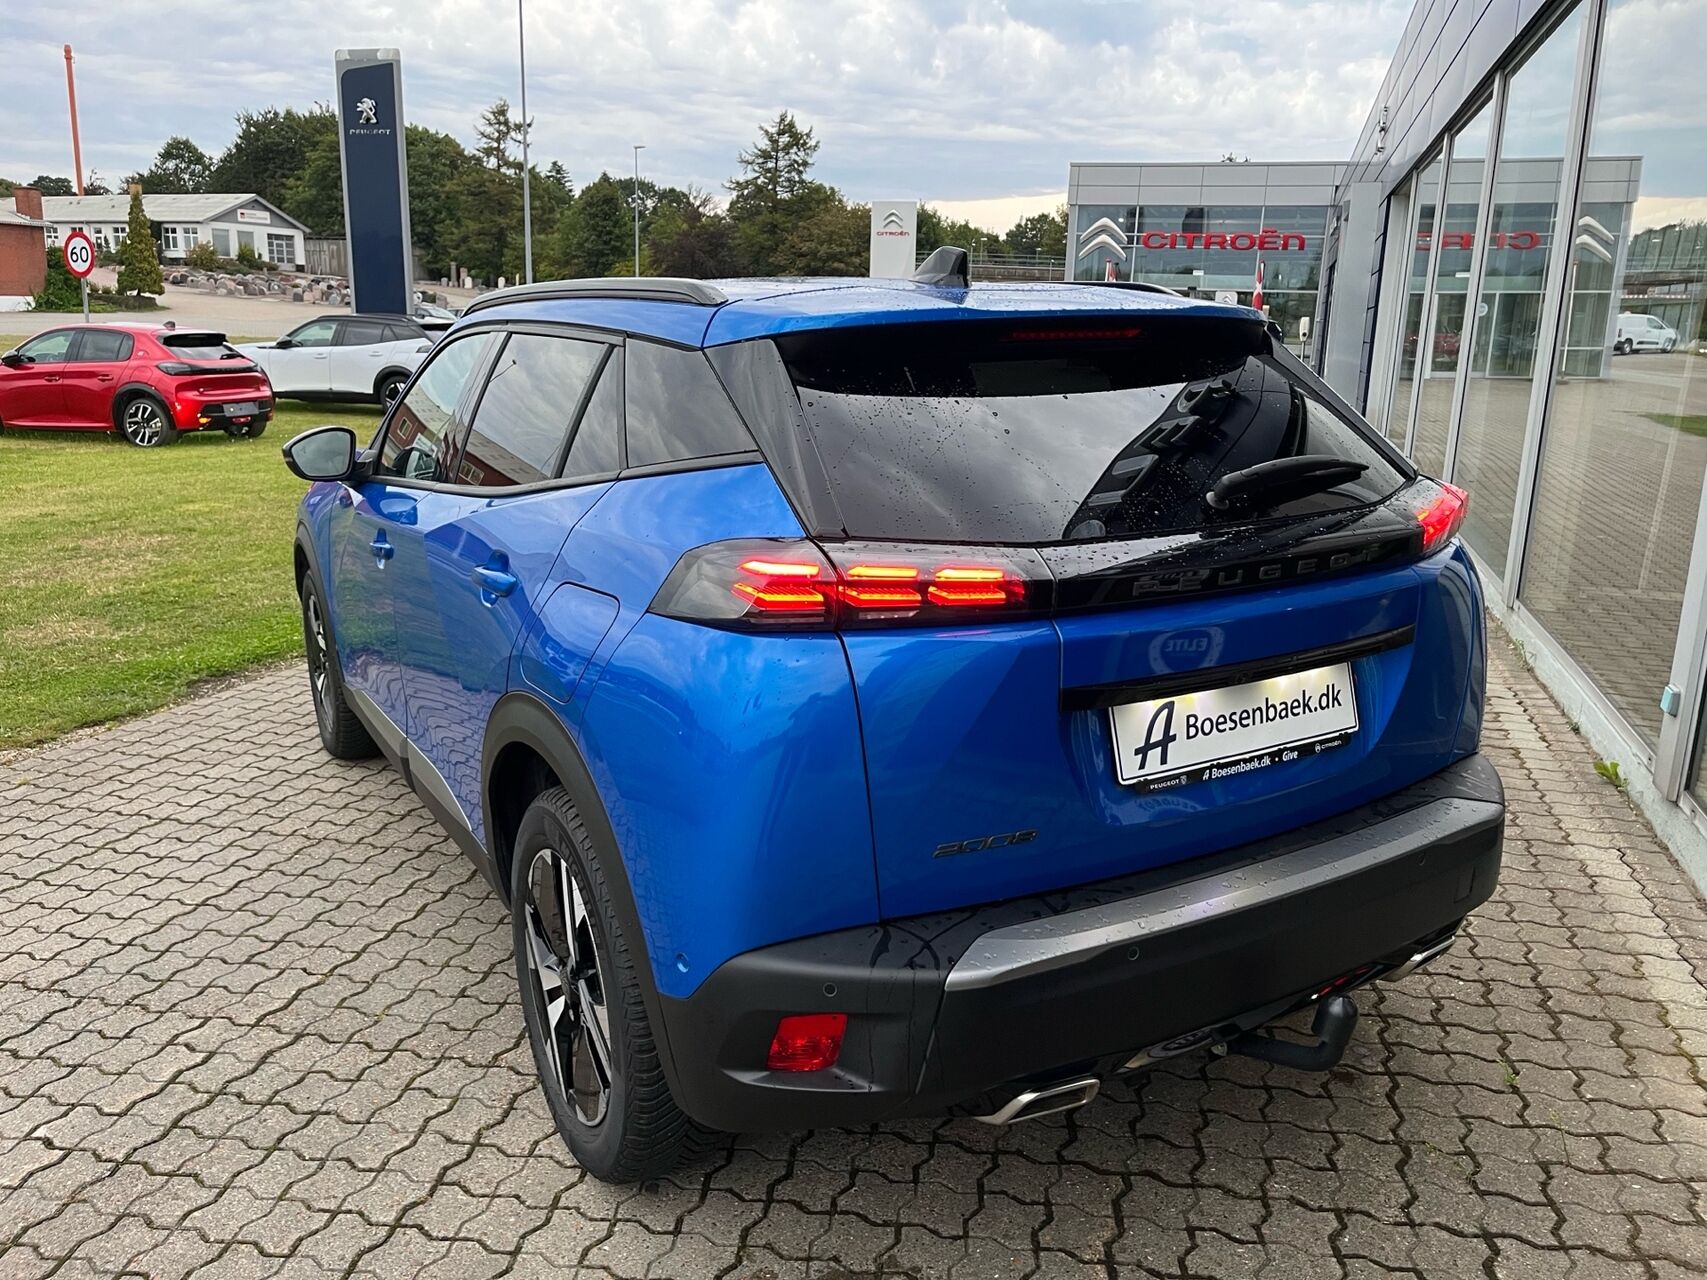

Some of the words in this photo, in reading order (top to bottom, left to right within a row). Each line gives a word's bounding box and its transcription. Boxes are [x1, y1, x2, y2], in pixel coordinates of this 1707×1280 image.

[70, 246, 89, 263] 60
[1132, 544, 1381, 597] PEUGEOT
[1185, 683, 1343, 741] Boesenbaek.dk
[1211, 755, 1271, 779] Boesenbaek.dk
[1282, 750, 1298, 762] Give
[1150, 779, 1180, 790] PEUGEOT
[931, 828, 1040, 859] 2008
